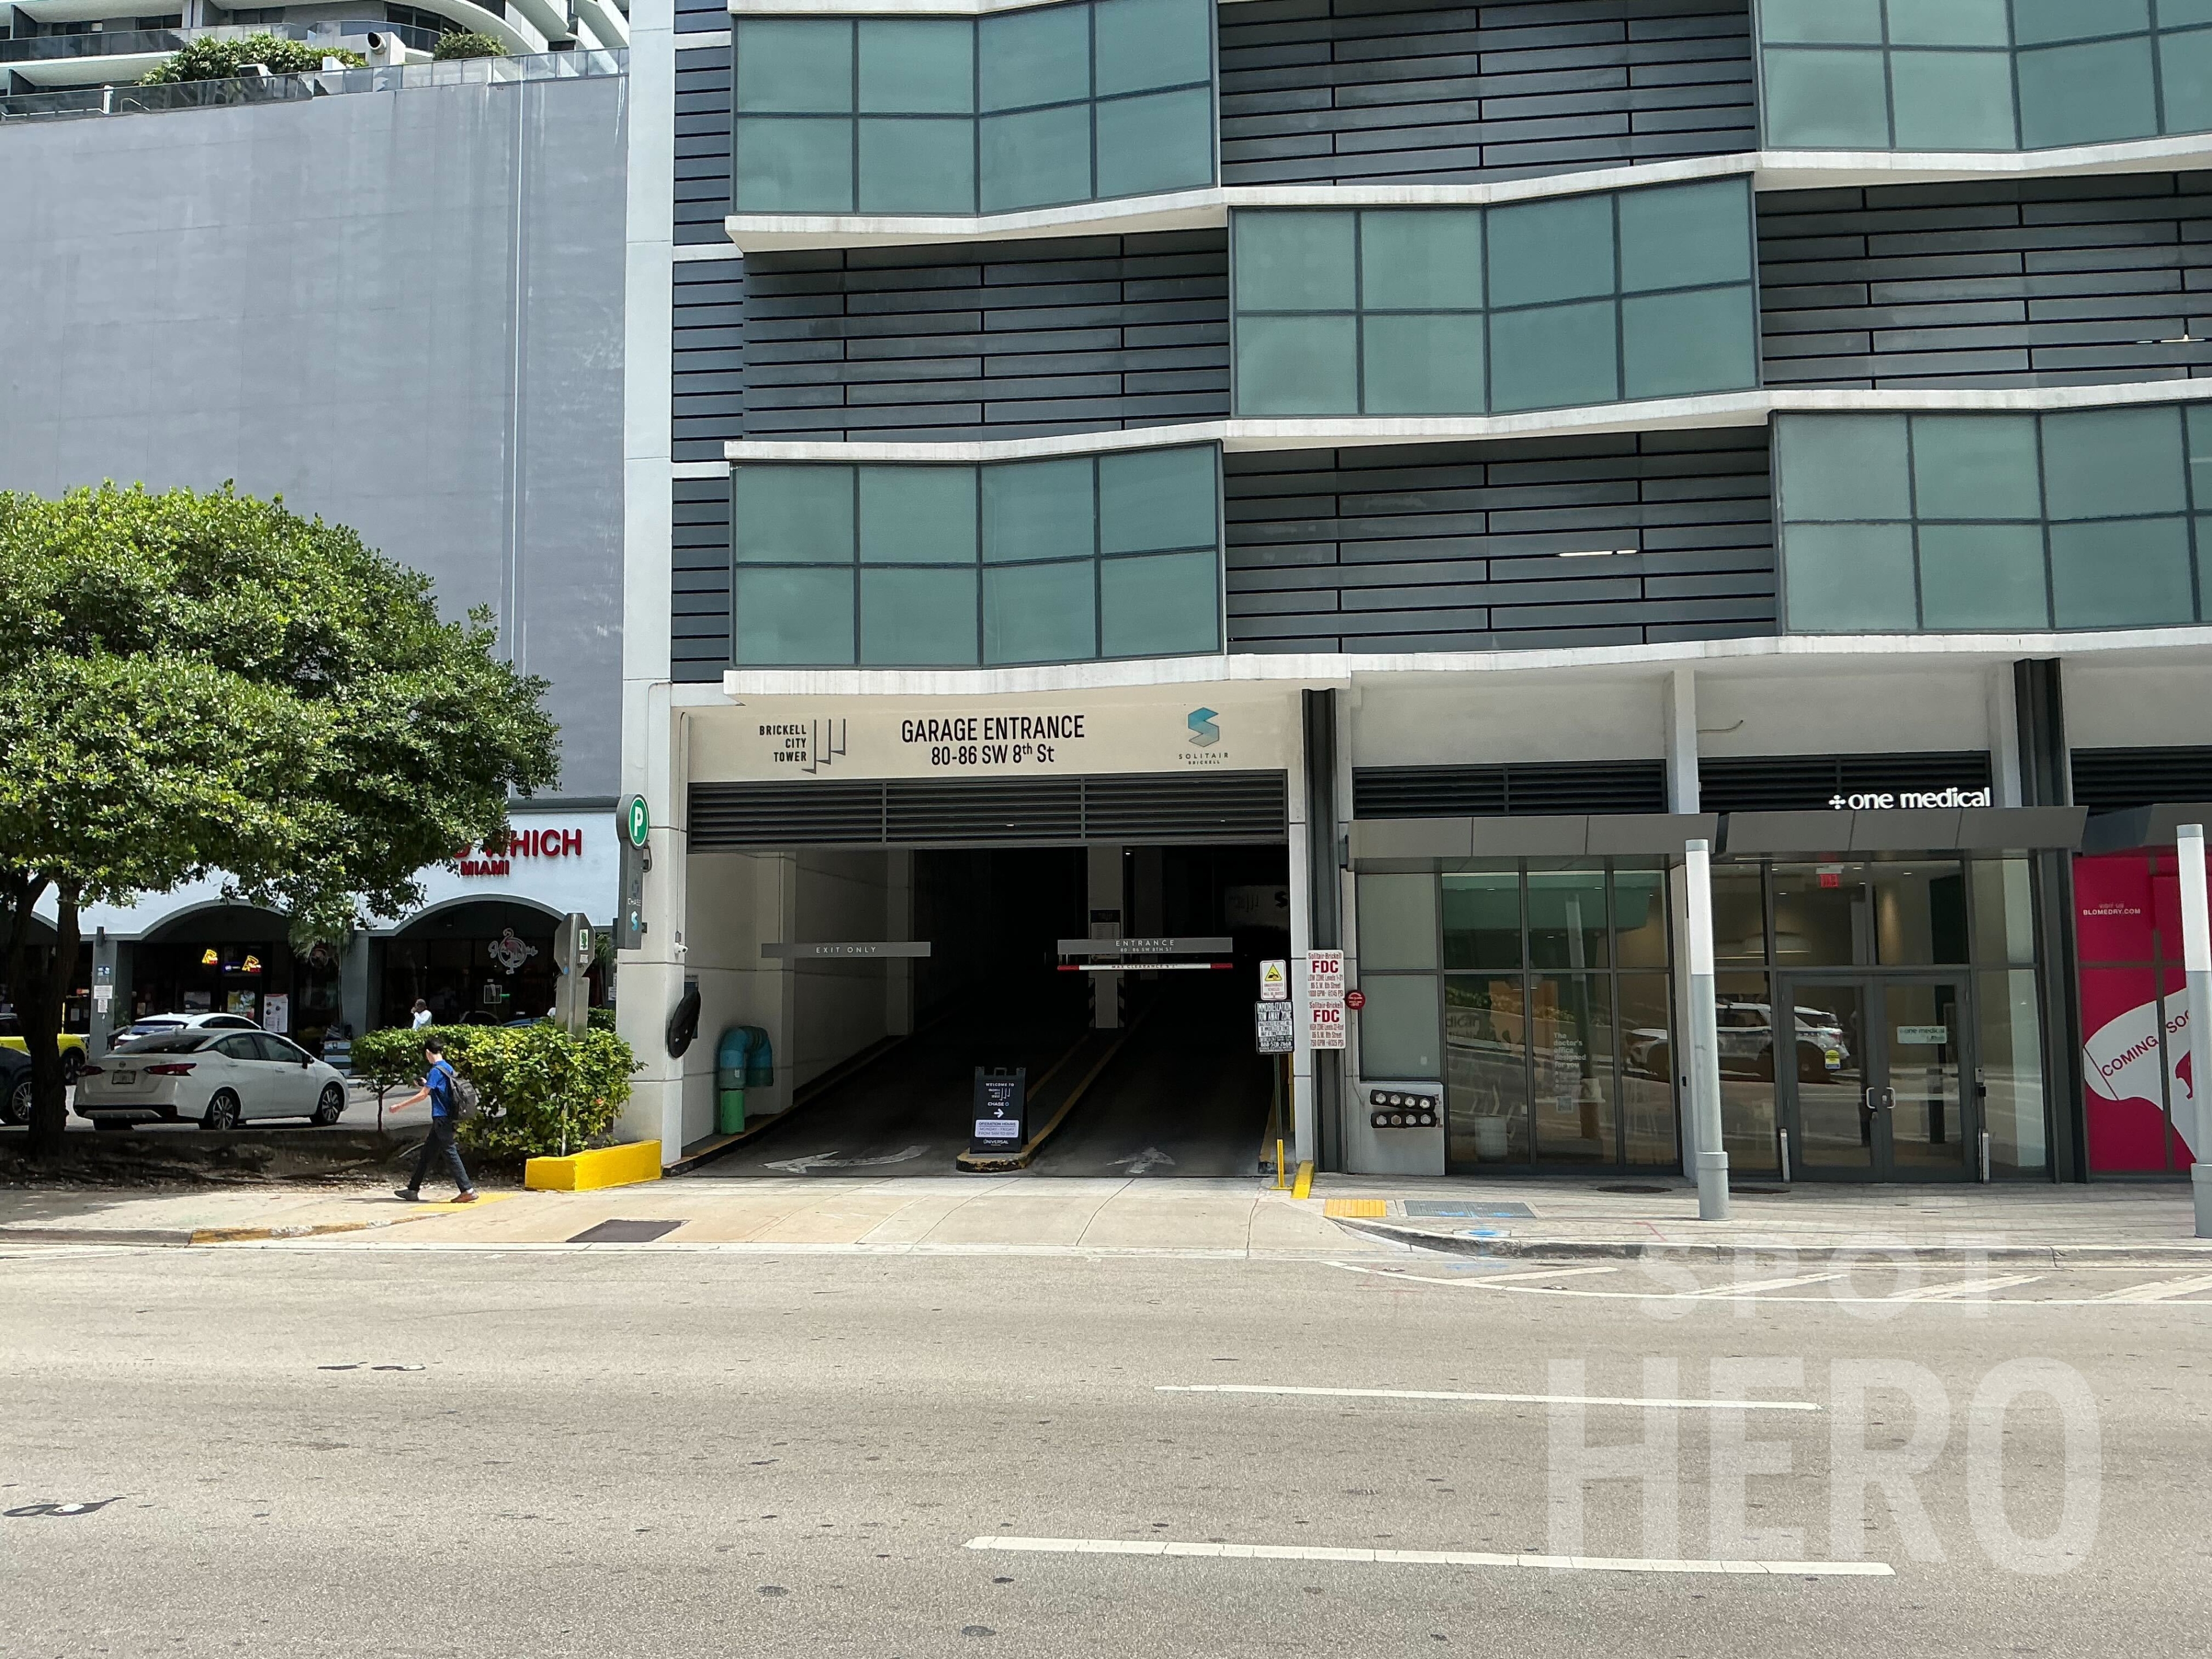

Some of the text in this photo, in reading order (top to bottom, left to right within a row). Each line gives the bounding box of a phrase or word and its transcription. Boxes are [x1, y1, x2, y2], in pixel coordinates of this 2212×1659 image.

[759, 725, 806, 735] BRICKELL
[902, 715, 1085, 743] GARAGE ENTRANCE
[785, 738, 806, 748] CITY
[774, 751, 806, 762] TOWER
[931, 743, 1055, 765] 80-86 SW 8th St
[1848, 787, 1991, 810] one medical
[634, 806, 643, 837] P
[460, 859, 510, 876] MIAMI
[2083, 908, 2141, 916] BLOMEDRY.COM
[1312, 960, 1339, 974] FDC
[1257, 1002, 1291, 1012] IMMOBILIZATION
[1257, 1010, 1292, 1021] TOW AWAY ZONE
[1313, 1009, 1340, 1022] FDC
[1554, 1054, 1586, 1062] designed
[2101, 1035, 2160, 1077] COMING
